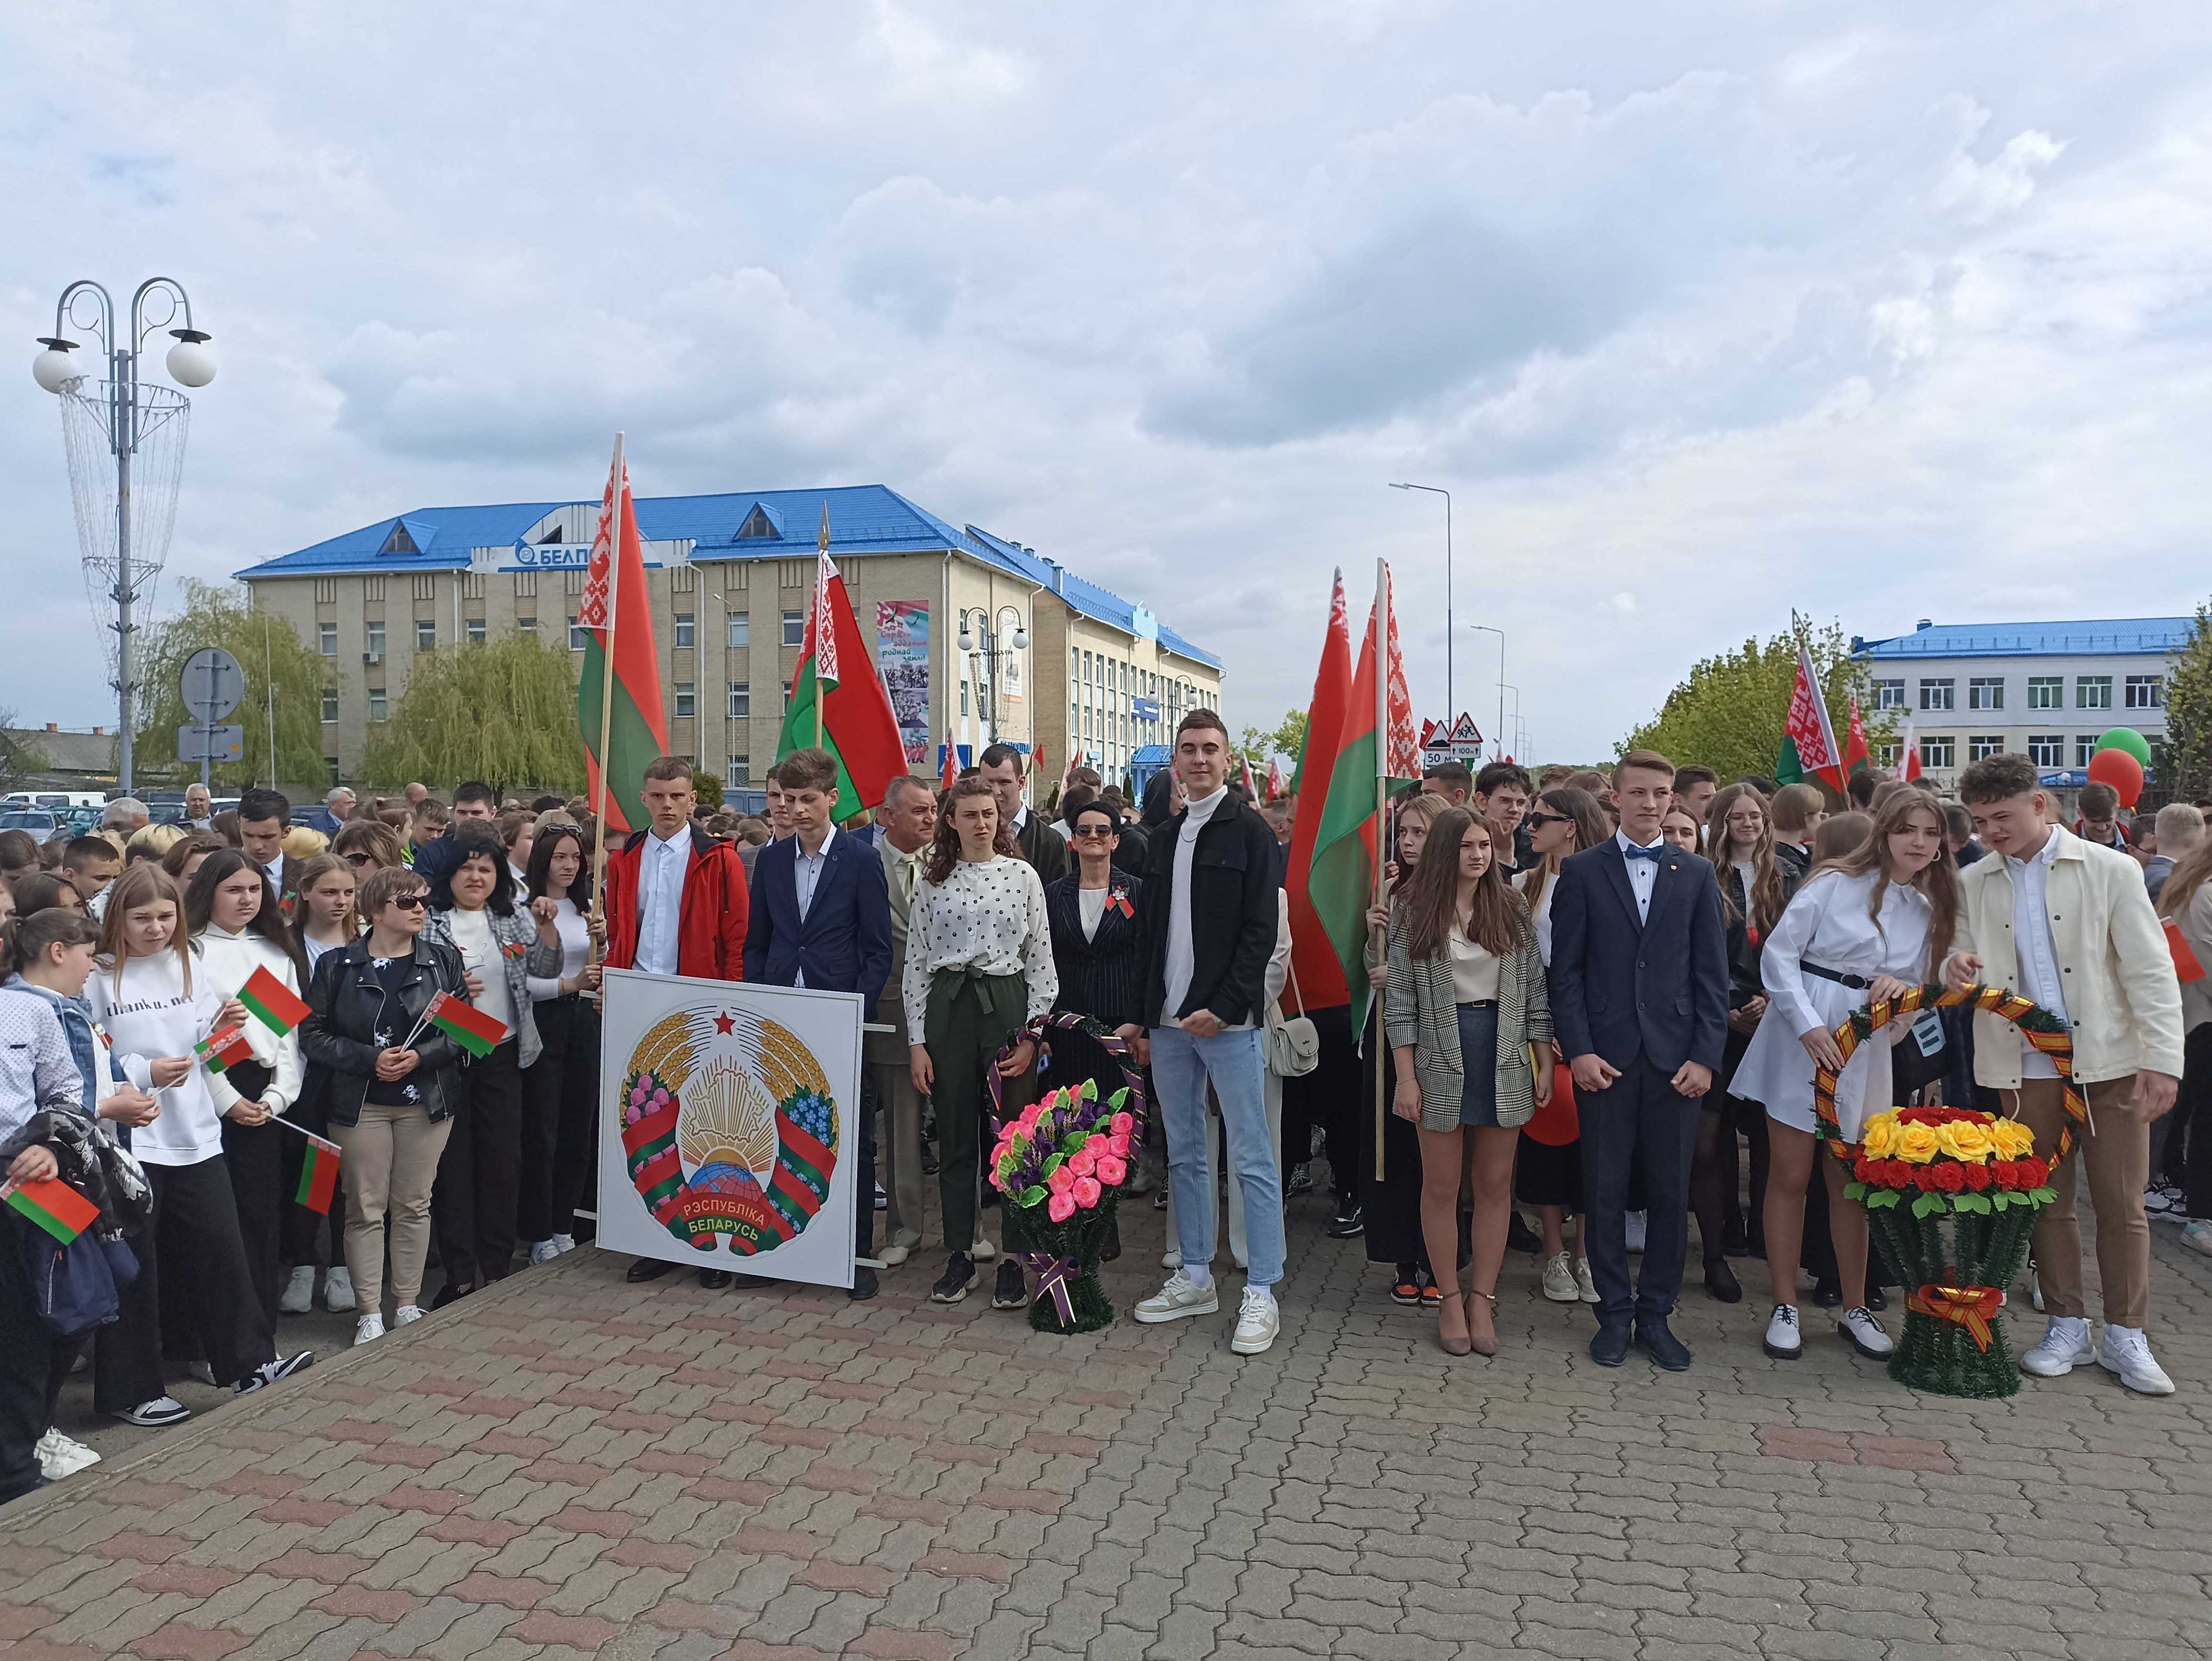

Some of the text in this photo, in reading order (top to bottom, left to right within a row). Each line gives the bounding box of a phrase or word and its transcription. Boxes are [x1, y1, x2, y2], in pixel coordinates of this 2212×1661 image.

[541, 548, 591, 565] БЕЛП
[882, 648, 911, 659] роднай
[1428, 753, 1440, 763] 50
[684, 1199, 764, 1226] РЭСПУБЛІКА
[688, 1218, 759, 1240] БЕЛАРУСЬ
